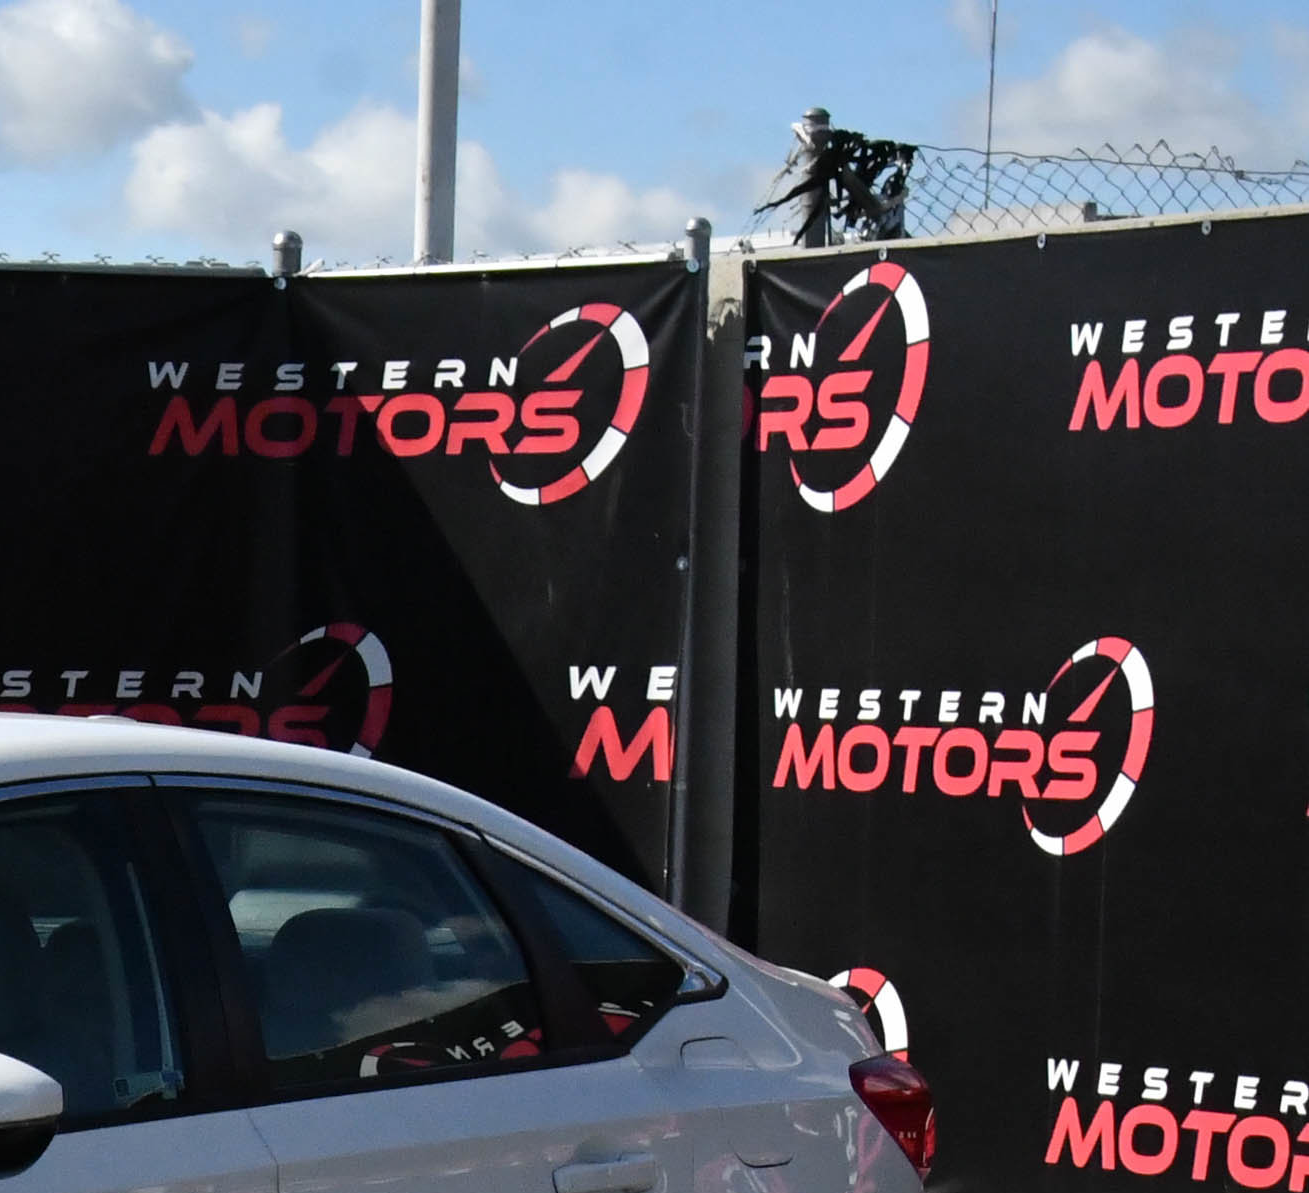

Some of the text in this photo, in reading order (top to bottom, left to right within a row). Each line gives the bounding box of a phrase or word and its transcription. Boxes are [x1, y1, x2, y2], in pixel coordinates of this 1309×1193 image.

[1071, 310, 1286, 356] WESTE
[150, 357, 518, 390] WESTERN
[1068, 347, 1309, 432] MOTO
[151, 389, 583, 457] MOTORS
[774, 688, 1047, 724] WESTERN
[772, 722, 1102, 800] MOTORS
[1048, 1058, 1309, 1115] WESTER
[1044, 1096, 1309, 1193] MOTO
